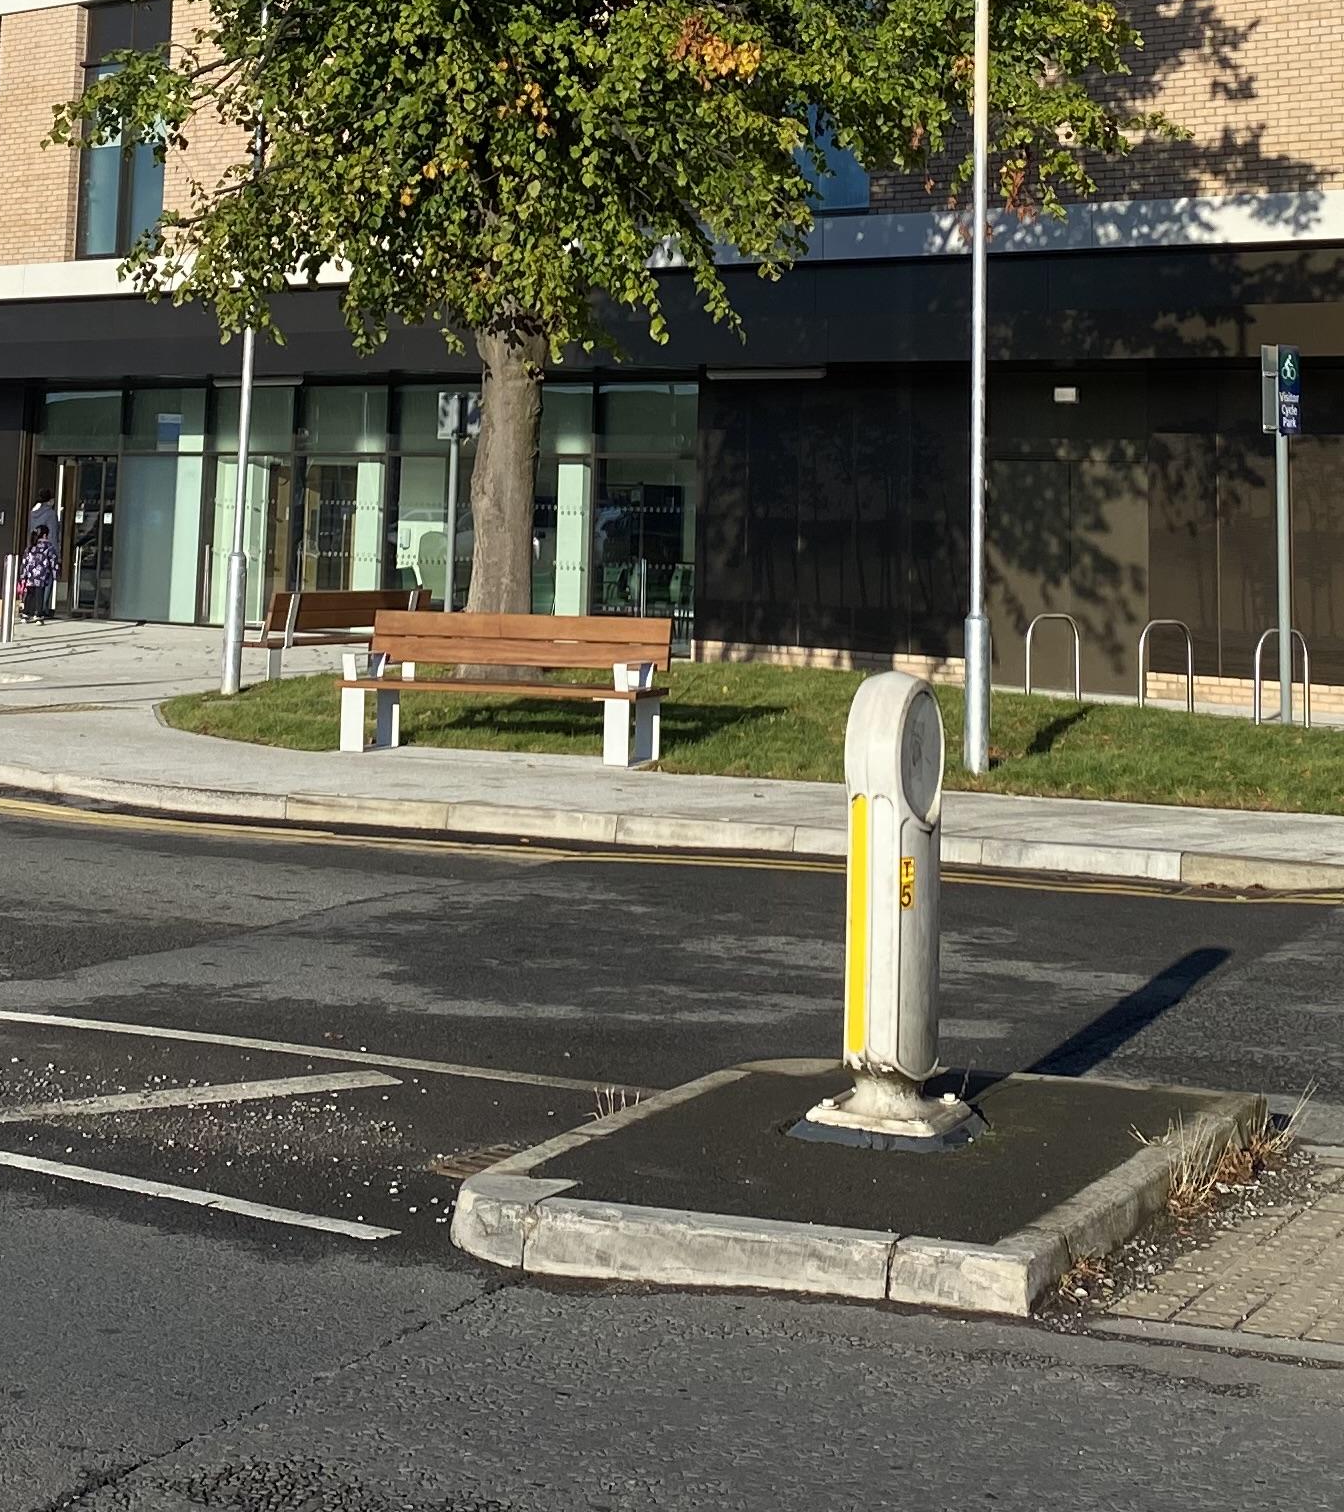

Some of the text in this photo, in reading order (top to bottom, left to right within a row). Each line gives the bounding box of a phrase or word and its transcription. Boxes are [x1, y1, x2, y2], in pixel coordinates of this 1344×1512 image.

[1278, 391, 1300, 403] Visitor
[1281, 404, 1298, 417] Cycle
[1282, 416, 1297, 428] Park
